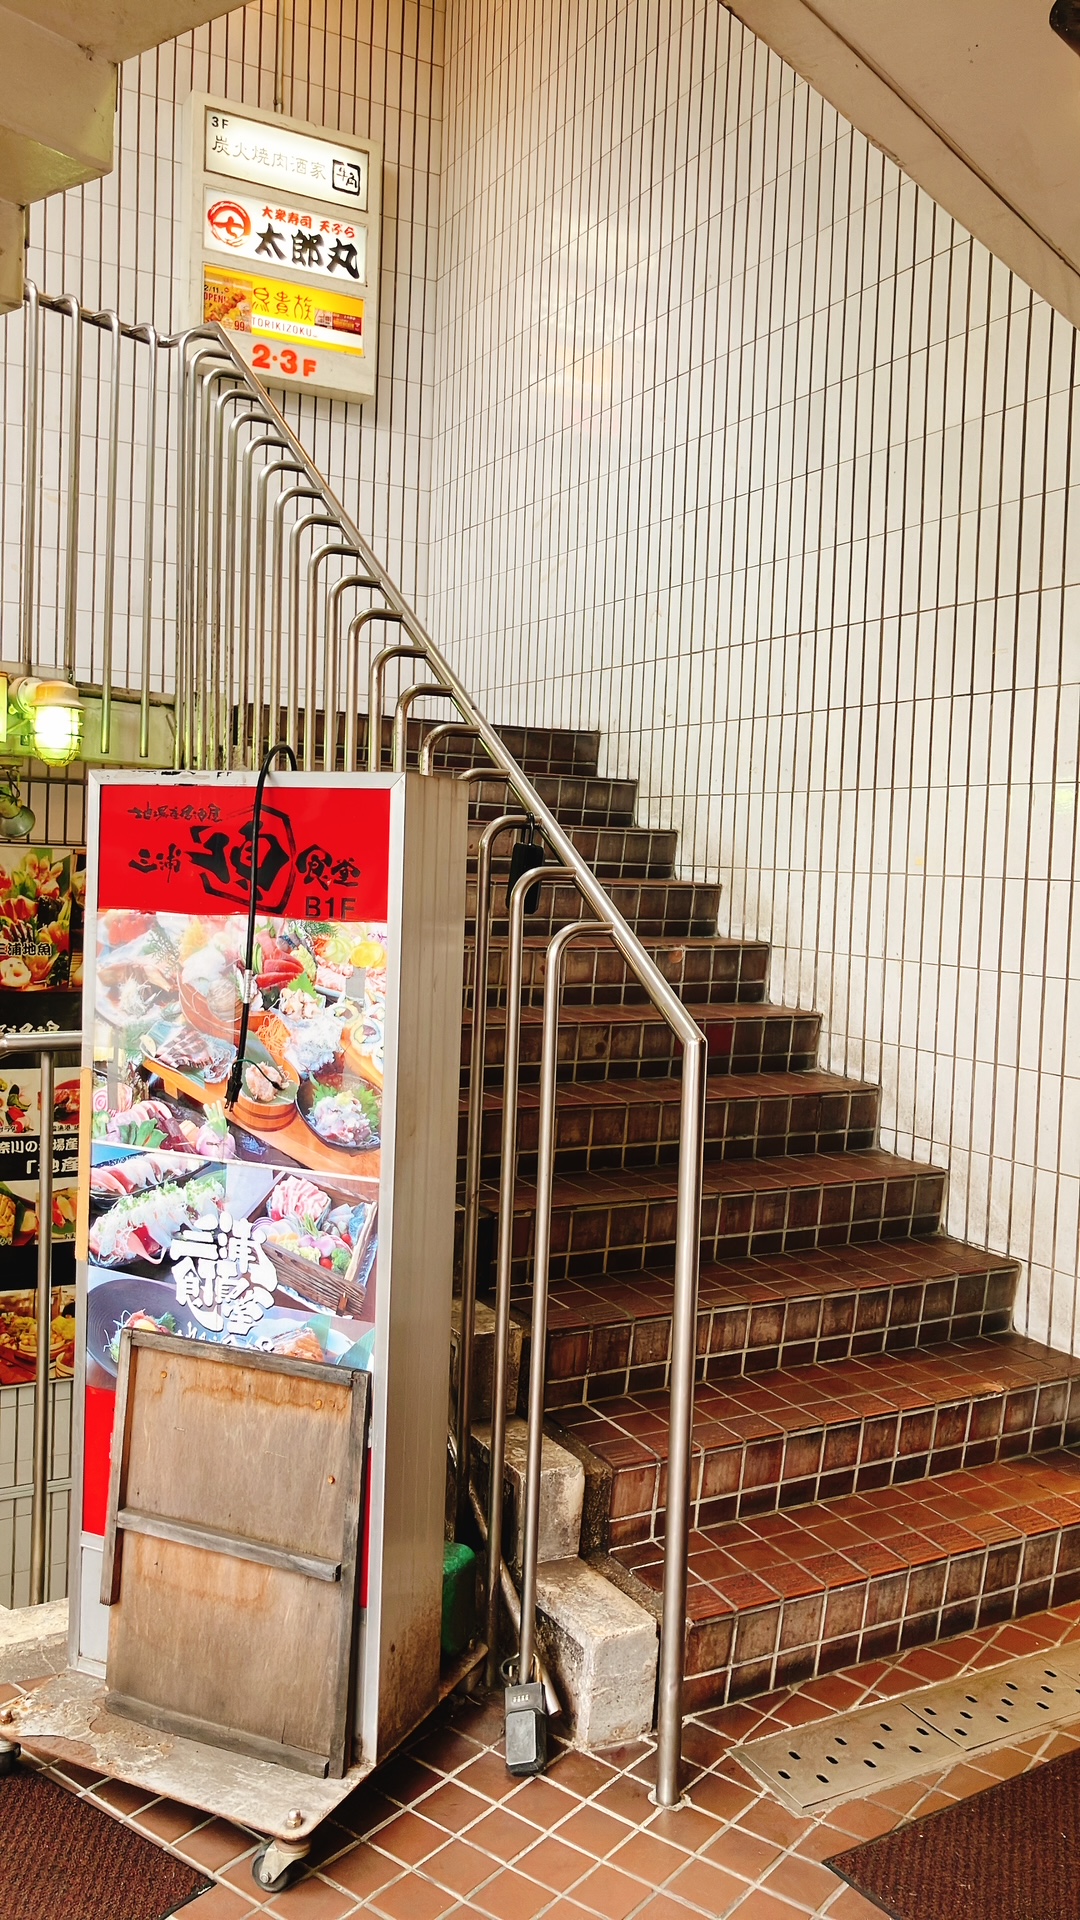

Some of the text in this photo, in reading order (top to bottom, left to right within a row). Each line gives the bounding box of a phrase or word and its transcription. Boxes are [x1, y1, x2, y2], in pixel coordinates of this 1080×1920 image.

[211, 116, 229, 129] 3F
[211, 135, 326, 180] 炭火焼肉酒家
[336, 166, 358, 188] 牛角
[262, 206, 355, 239] 大衆寿司 天ぷら
[254, 222, 360, 279] 太郎丸
[252, 287, 312, 322] 鳥貴族
[252, 316, 312, 337] TORIKIZOKU
[306, 896, 356, 919] B1F
